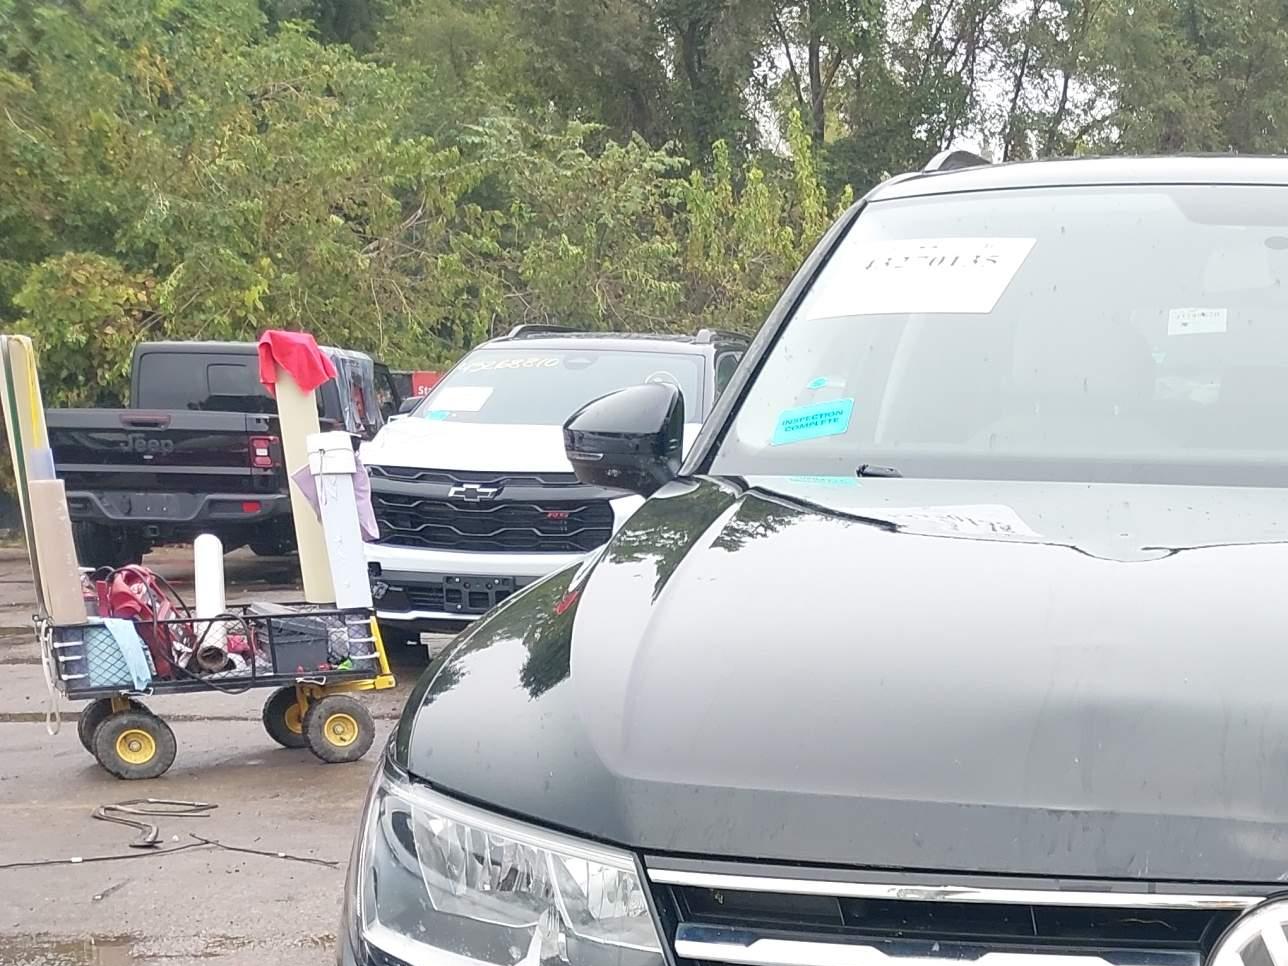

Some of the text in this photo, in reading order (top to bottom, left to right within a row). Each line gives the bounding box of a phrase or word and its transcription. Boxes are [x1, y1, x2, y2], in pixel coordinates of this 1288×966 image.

[782, 410, 844, 426] INSPECTION
[783, 417, 840, 432] COMPLETE
[119, 433, 174, 455] Jeep
